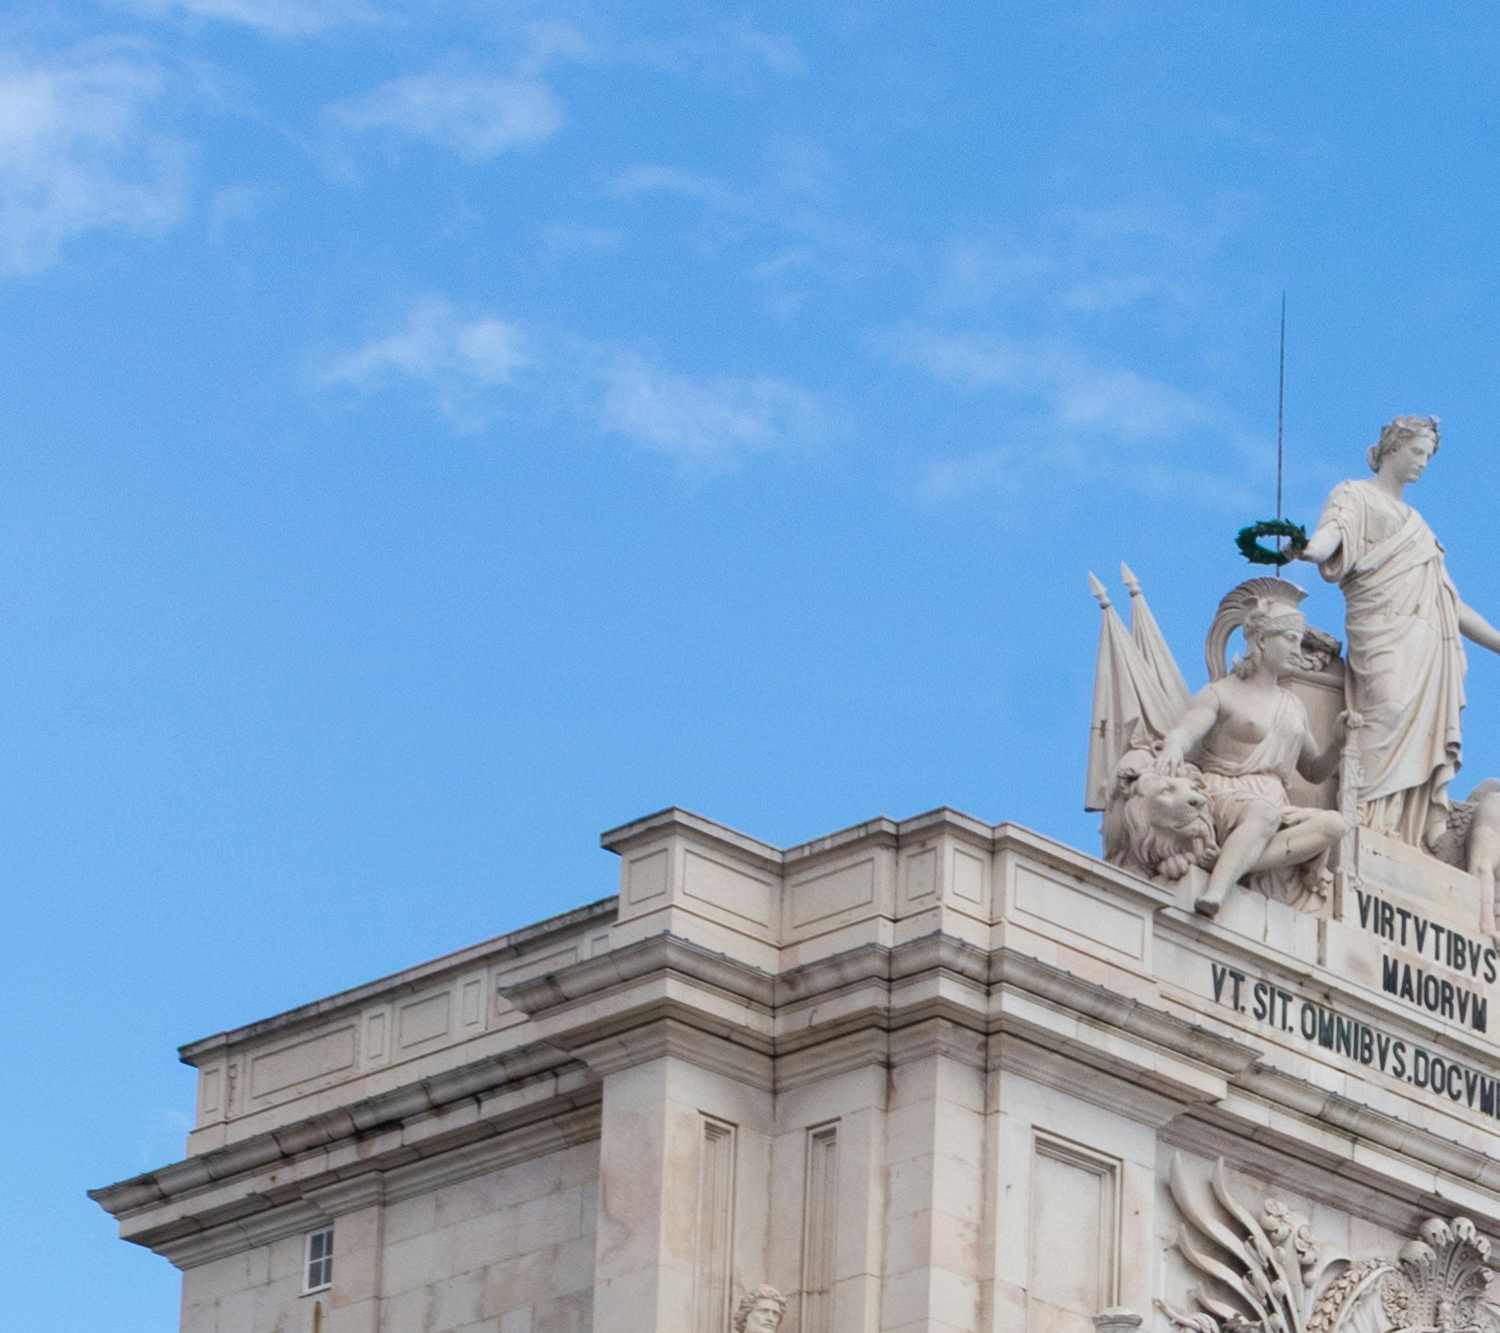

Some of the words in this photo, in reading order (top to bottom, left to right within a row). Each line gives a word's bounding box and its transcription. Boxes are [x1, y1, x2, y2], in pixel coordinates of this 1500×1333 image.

[1357, 889, 1496, 984] VIRTVTIBVS
[1211, 963, 1246, 1014] VT.
[1253, 982, 1294, 1033] SIT.
[1383, 954, 1487, 1034] MAIORVM
